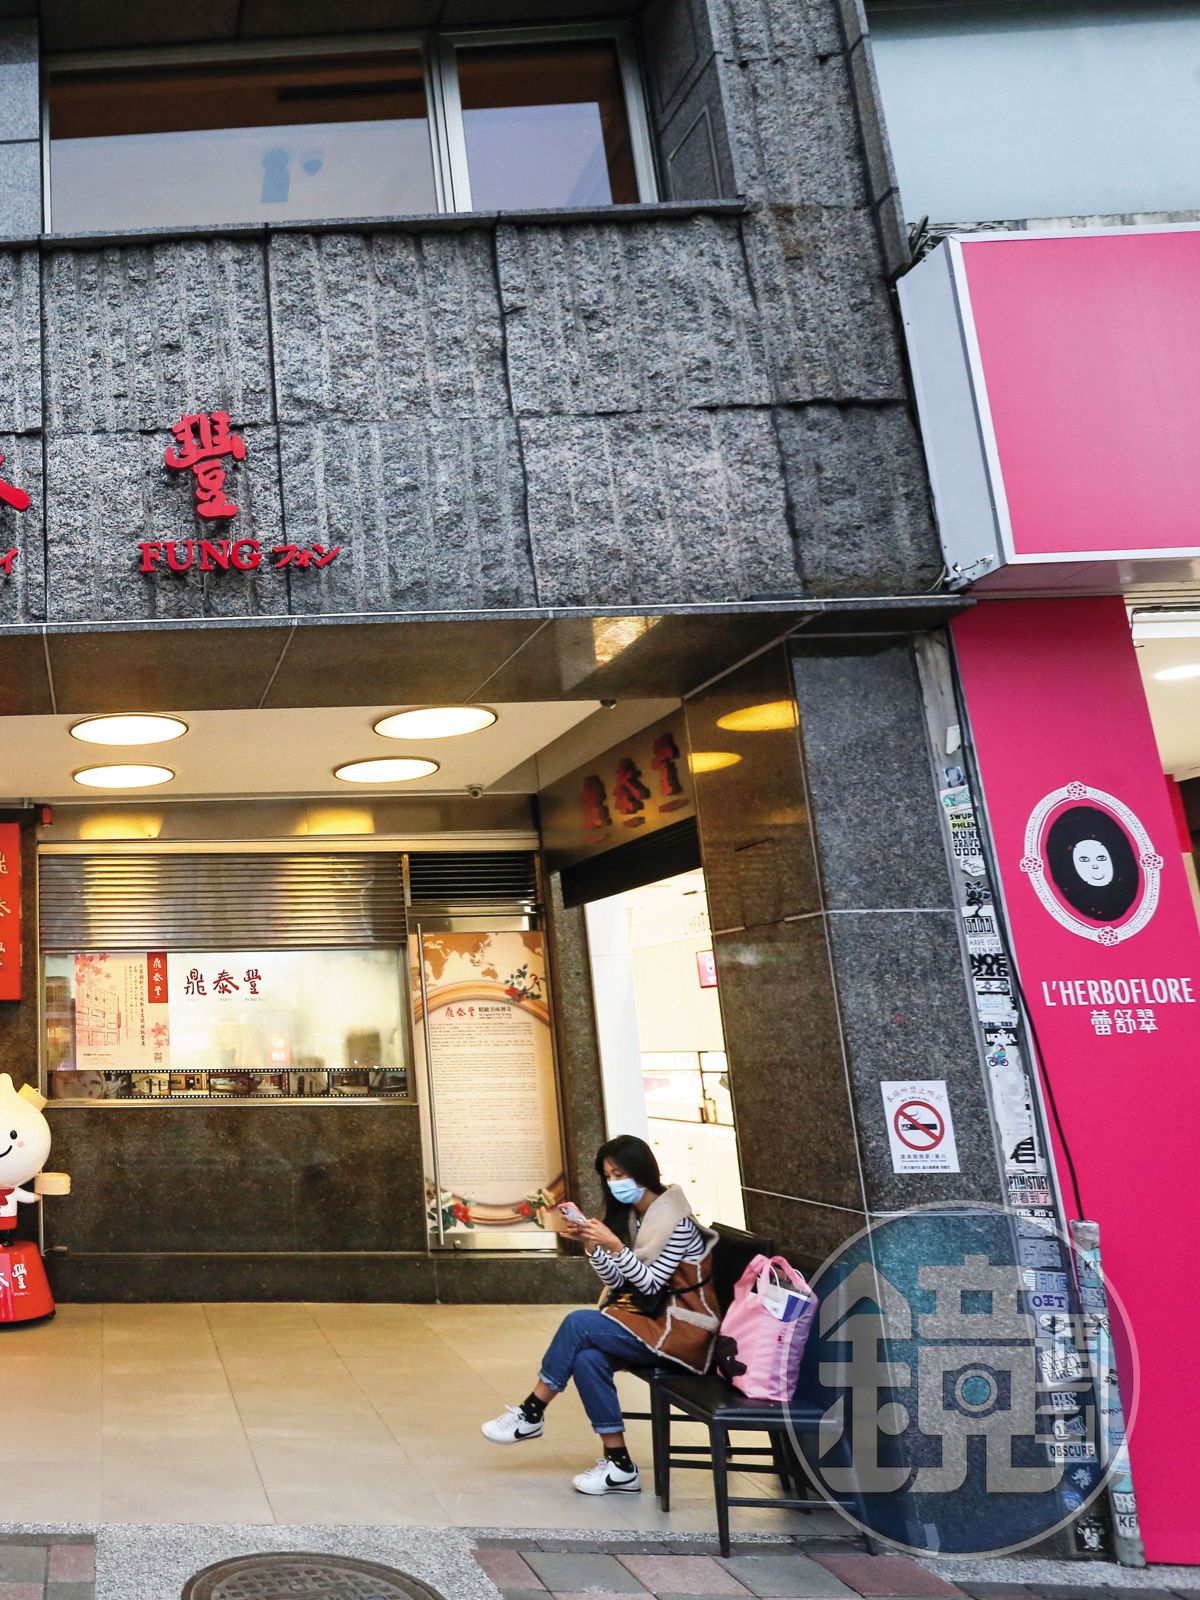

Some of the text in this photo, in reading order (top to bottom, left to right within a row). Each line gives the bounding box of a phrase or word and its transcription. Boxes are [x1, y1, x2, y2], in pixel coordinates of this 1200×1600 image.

[138, 539, 264, 574] FUNG
[272, 543, 341, 569] フォン
[183, 967, 263, 996] 鼎泰豐
[1090, 1009, 1158, 1036] 蕾舒翠
[1050, 1444, 1096, 1457] OBSCURE
